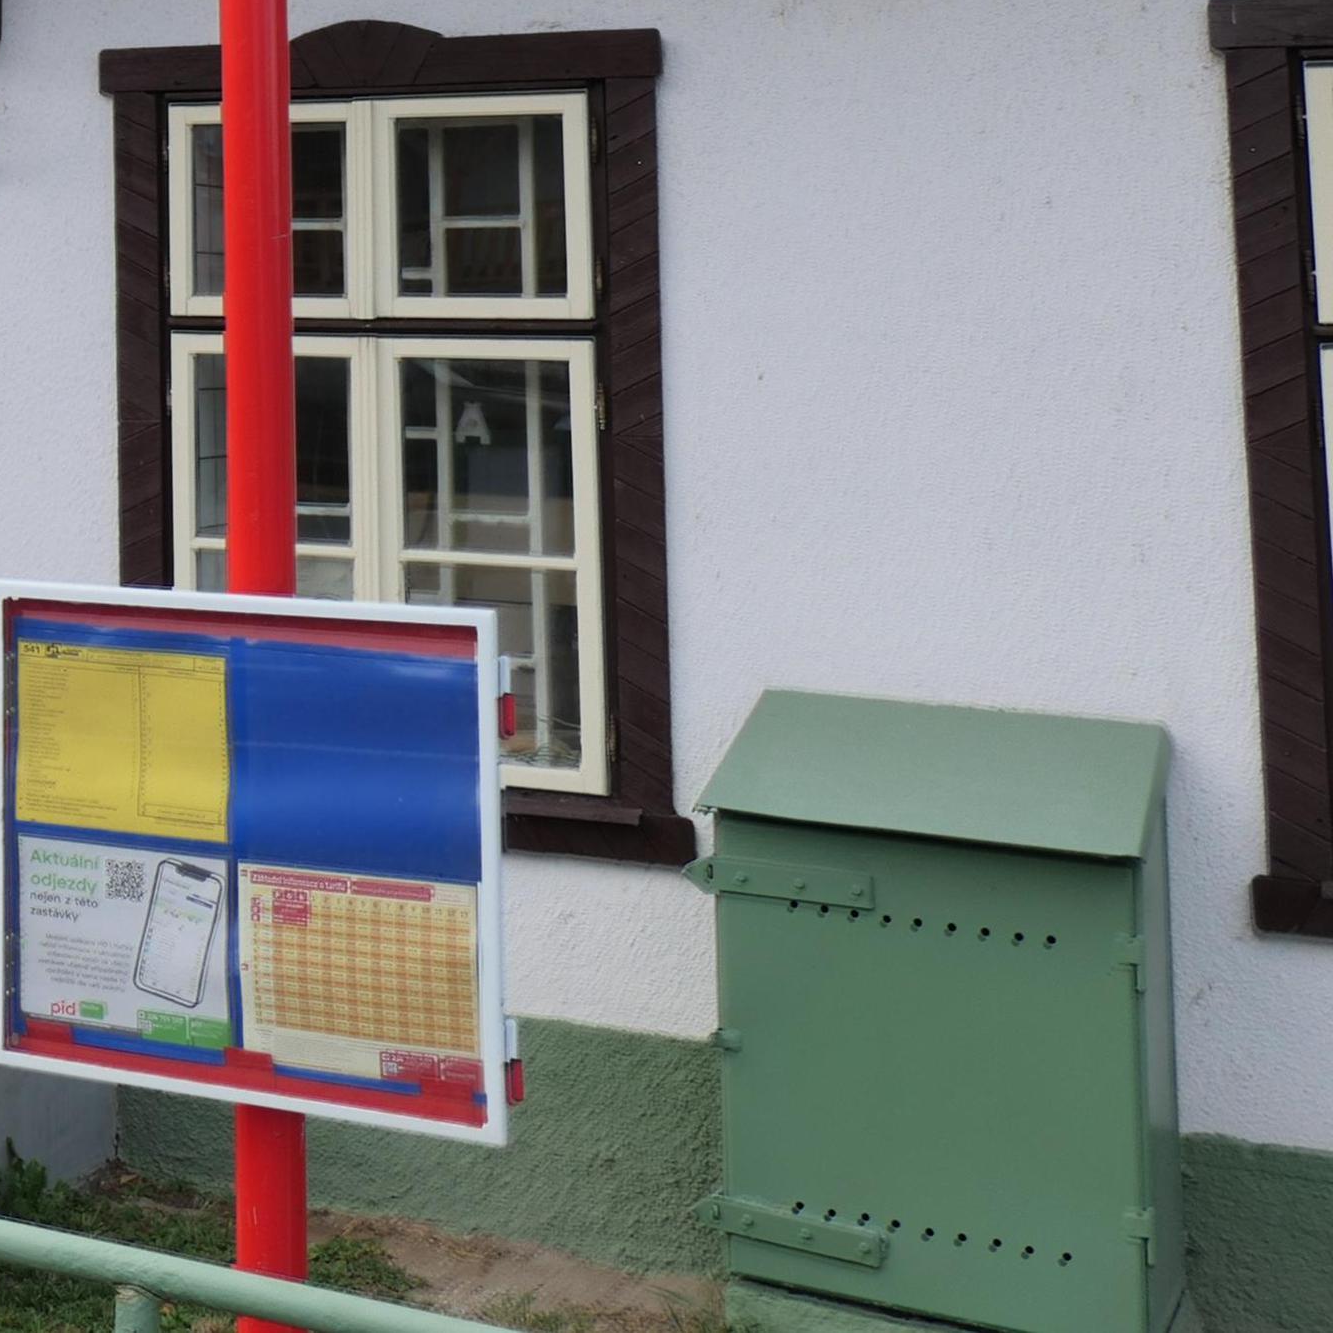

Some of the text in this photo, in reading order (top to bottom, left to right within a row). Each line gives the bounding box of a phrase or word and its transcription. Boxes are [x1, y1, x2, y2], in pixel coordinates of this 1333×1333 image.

[29, 849, 101, 871] Aktuální
[30, 873, 98, 897] odjezdy
[29, 891, 62, 905] nejen
[29, 906, 80, 923] zastávky
[50, 999, 77, 1018] pid
